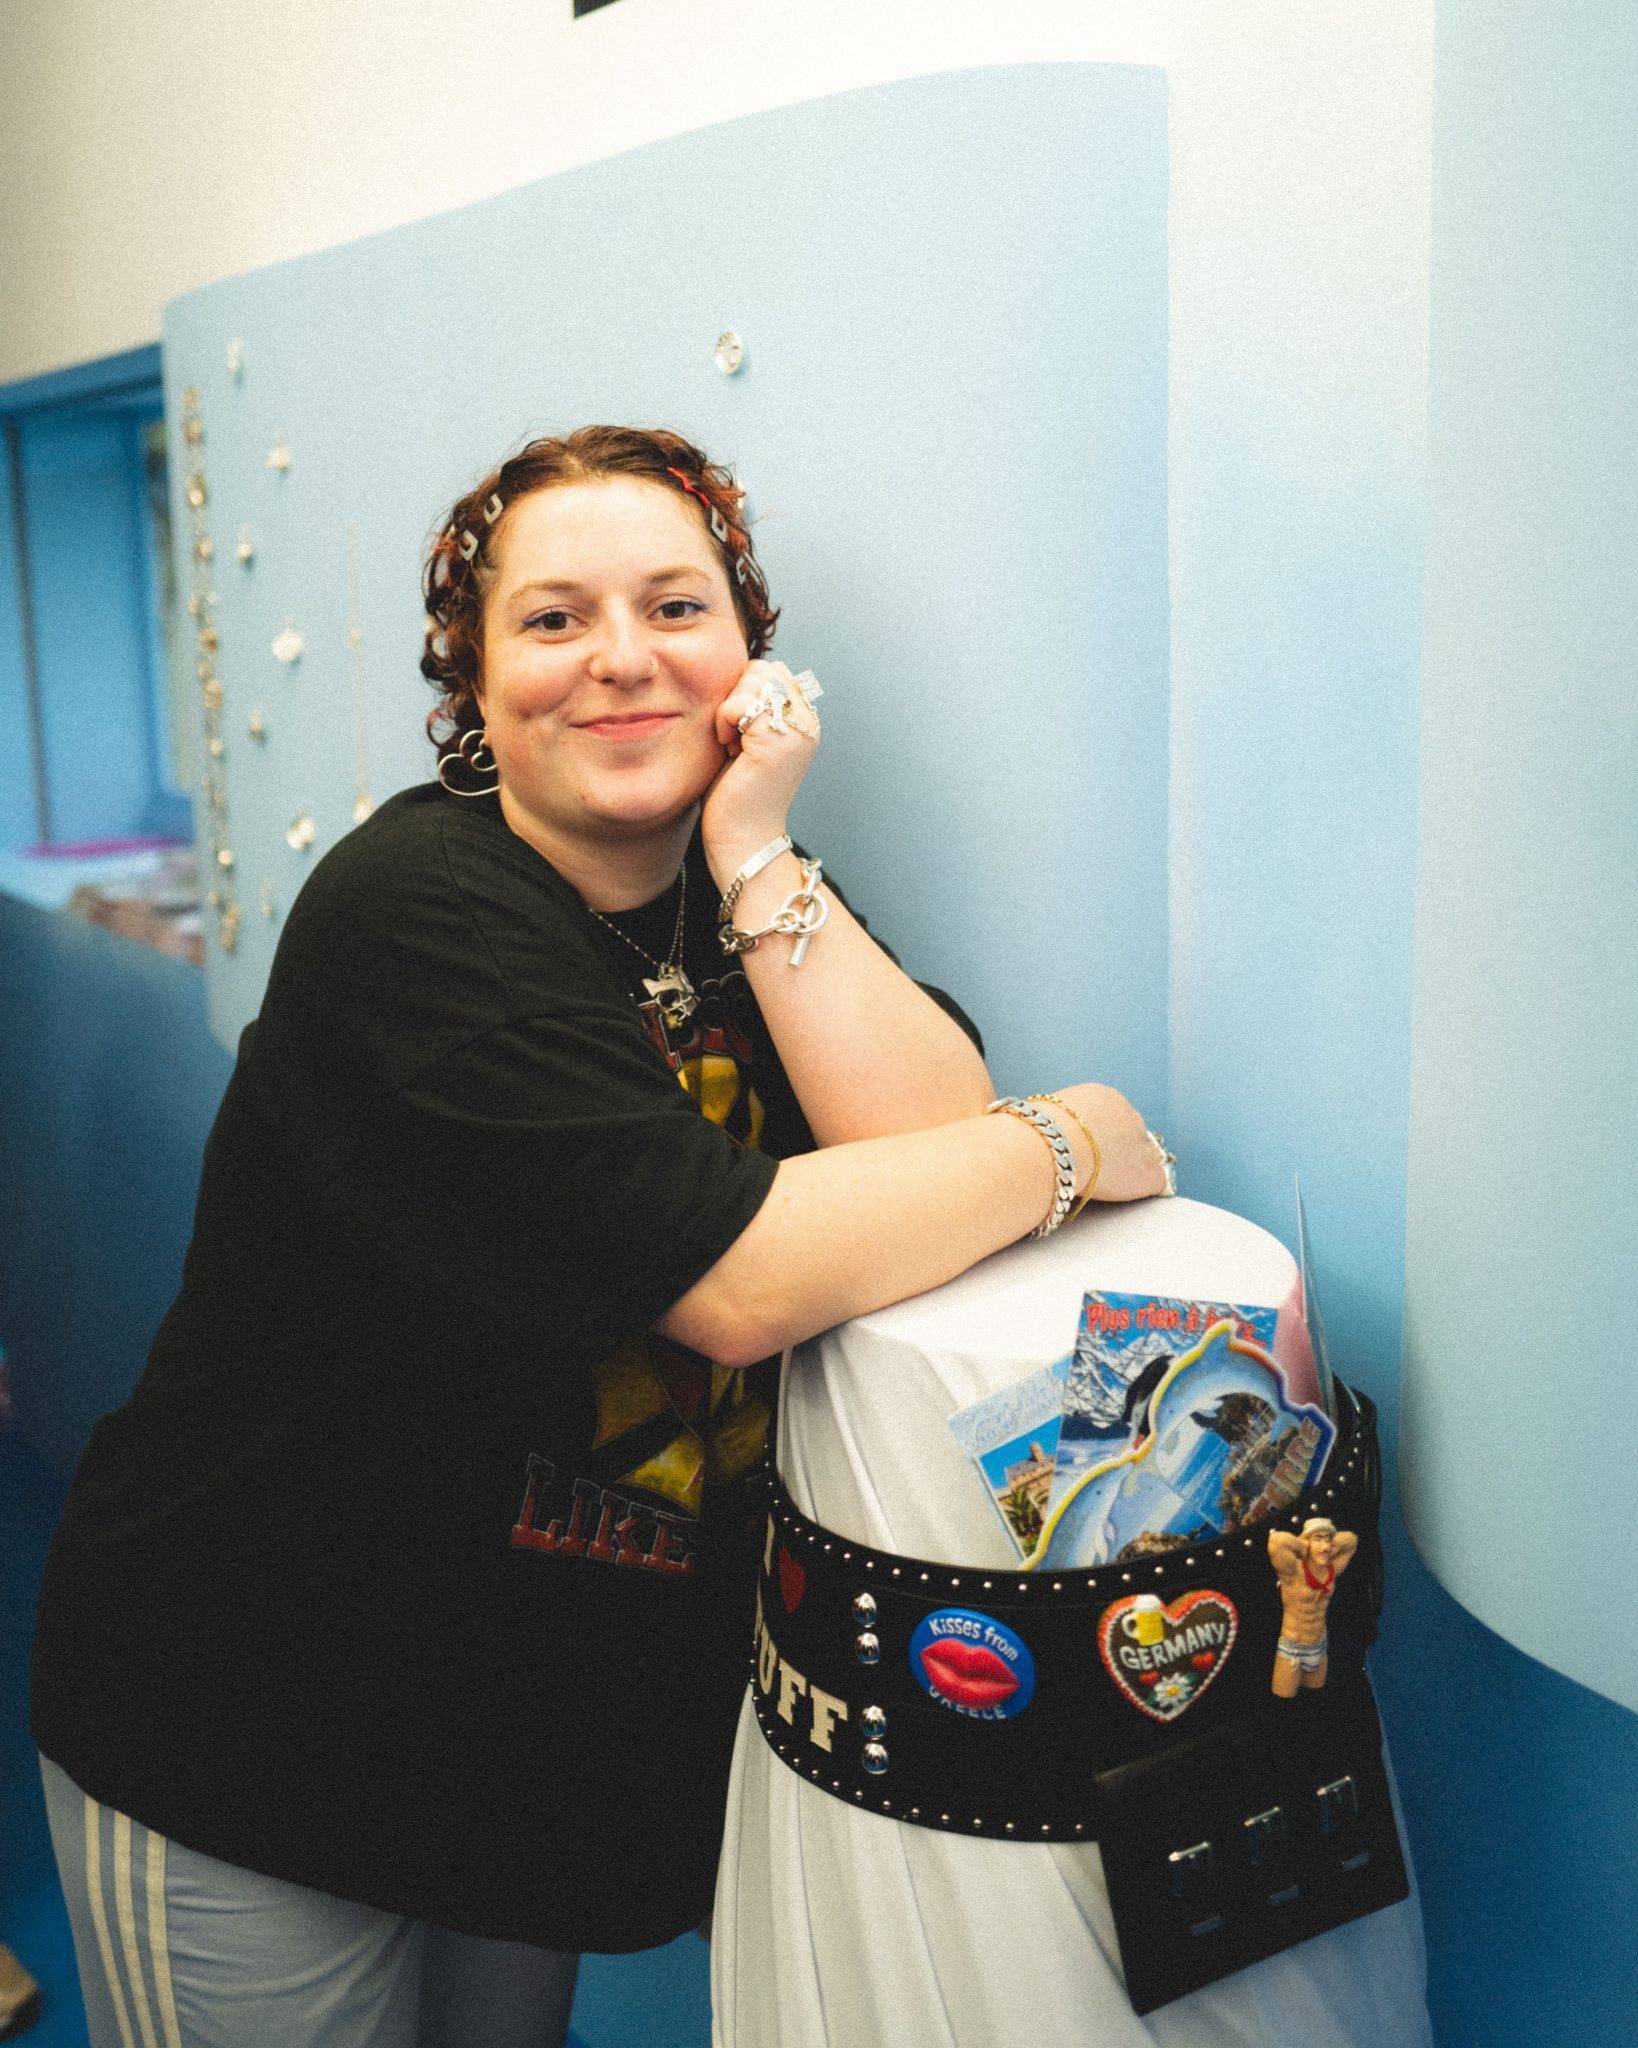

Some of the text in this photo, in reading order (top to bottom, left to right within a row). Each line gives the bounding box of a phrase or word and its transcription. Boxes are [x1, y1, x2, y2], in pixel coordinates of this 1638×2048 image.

[1086, 1302, 1130, 1331] Plus
[1136, 1302, 1180, 1328] rien
[1184, 1303, 1199, 1333] à
[511, 1452, 700, 1575] LIKE
[754, 1573, 848, 1753] UFF
[928, 1617, 1019, 1661] Kisses from
[1119, 1622, 1225, 1671] GERMANY
